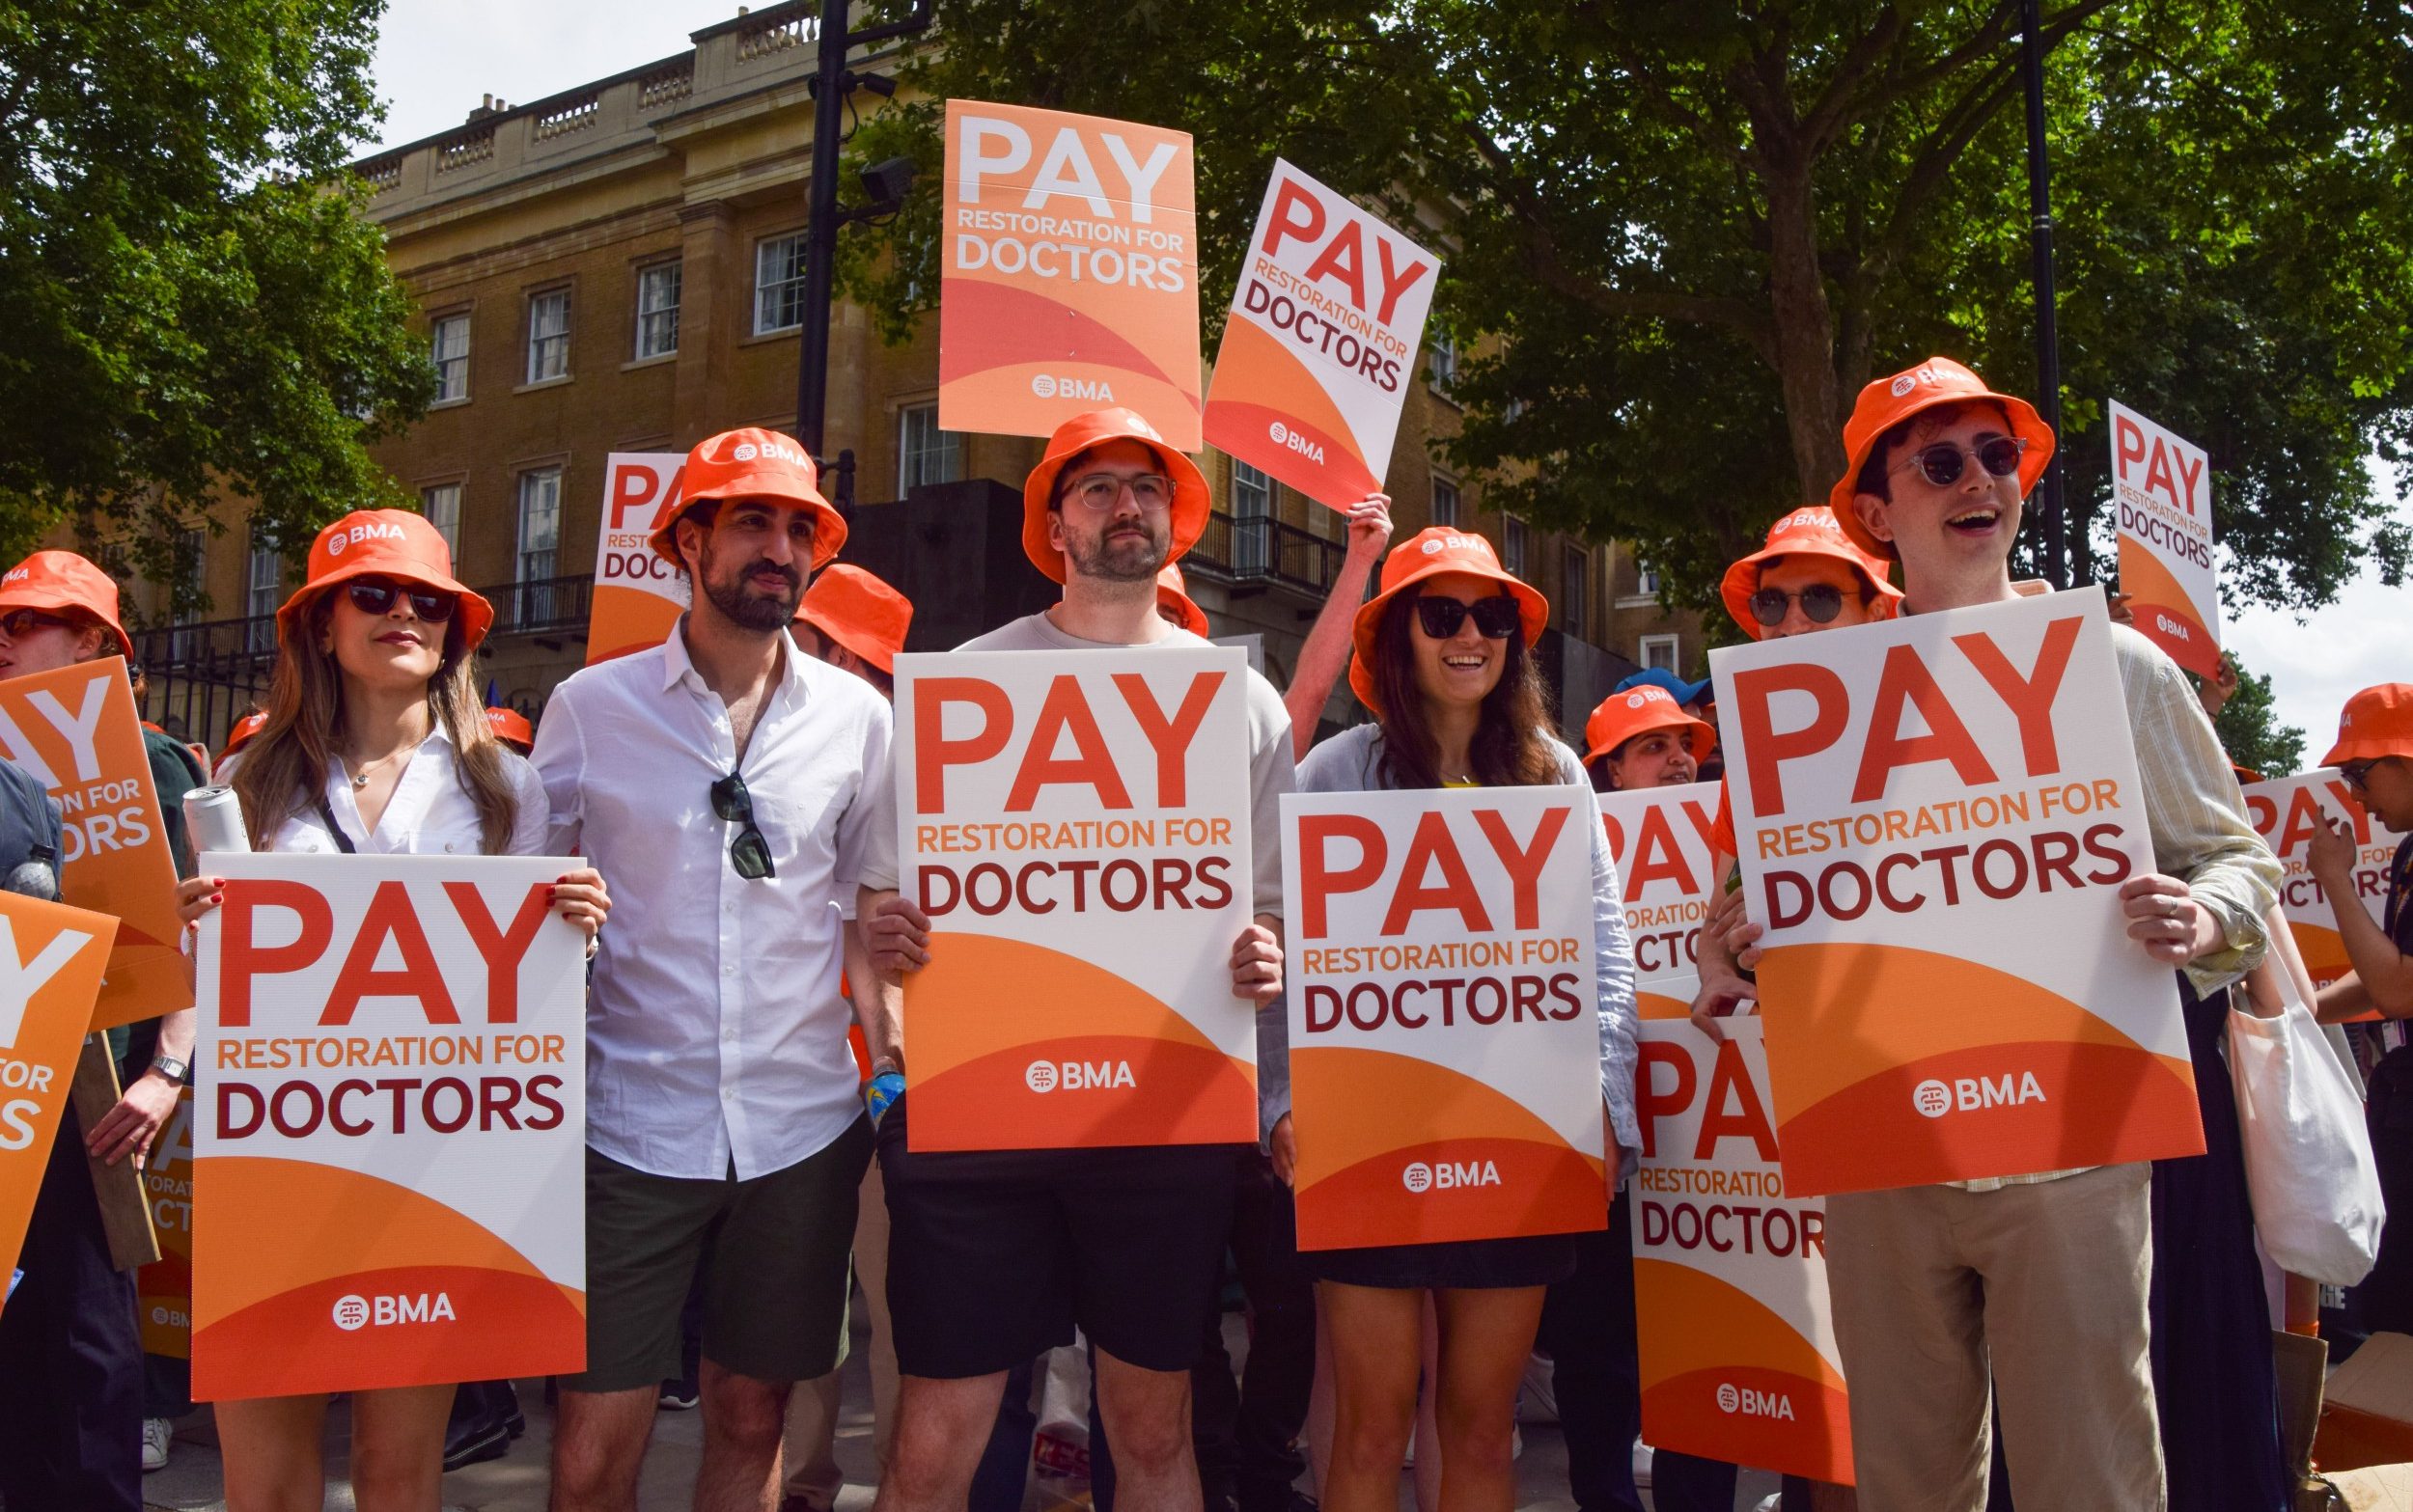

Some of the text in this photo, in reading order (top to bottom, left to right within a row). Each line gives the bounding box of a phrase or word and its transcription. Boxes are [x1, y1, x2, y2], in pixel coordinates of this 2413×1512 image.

[958, 116, 1179, 224] PAY
[957, 209, 1183, 254] RESTORATION FOR
[1262, 177, 1428, 326] PAY
[957, 234, 1185, 293] DOCTORS
[1255, 257, 1408, 361] RESTORATION FOR
[1244, 279, 1401, 394] DOCTORS
[1059, 377, 1113, 402] BMA
[761, 443, 808, 473] BMA
[1286, 429, 1324, 466] BMA
[2116, 413, 2203, 516] PAY
[350, 524, 406, 544] BMA
[1793, 514, 1840, 534] BMA
[2120, 483, 2207, 540] RESTORATION FOR
[2122, 502, 2209, 569] DOCTORS
[1446, 536, 1491, 558] BMA
[2167, 619, 2189, 642] BMA
[1733, 616, 2084, 817] PAY
[913, 672, 1227, 814] PAY
[89, 779, 141, 808] FOR
[917, 817, 1232, 853] RESTORATION FOR
[1757, 779, 2121, 860] RESTORATION FOR
[918, 856, 1233, 917] DOCTORS
[1298, 807, 1571, 939] PAY
[1762, 823, 2132, 930] DOCTORS
[218, 879, 551, 1027] PAY
[1303, 938, 1579, 975] RESTORATION FOR
[1304, 973, 1582, 1033] DOCTORS
[0, 1058, 54, 1093] OR
[217, 1034, 565, 1070] RESTORATION FOR
[1063, 1060, 1136, 1089] BMA
[216, 1074, 565, 1140] DOCTORS
[1635, 1038, 1781, 1162] PA
[1956, 1070, 2046, 1112] BMA
[1435, 1160, 1501, 1190] BMA
[1641, 1168, 1782, 1197] RESTORATIO
[1642, 1201, 1825, 1259] DOCTOR
[374, 1292, 456, 1326] BMA
[1742, 1389, 1794, 1421] BMA
